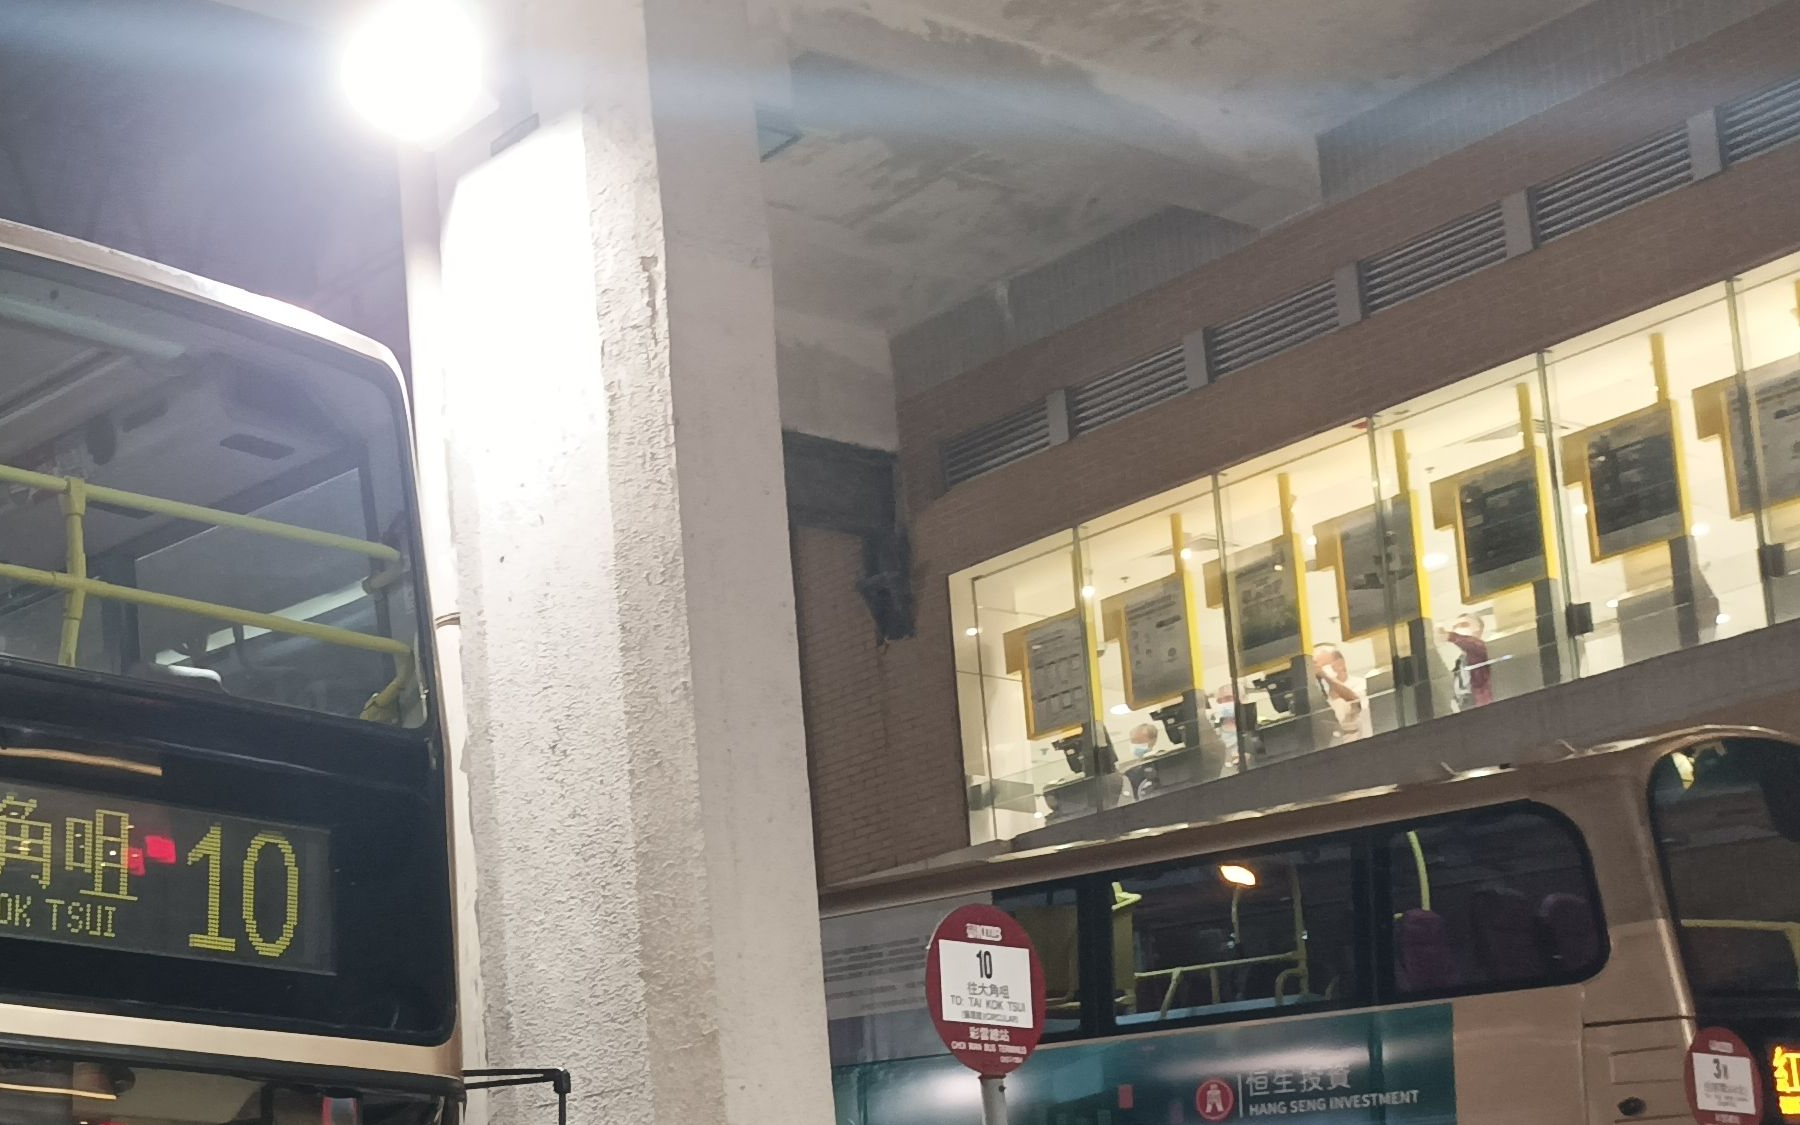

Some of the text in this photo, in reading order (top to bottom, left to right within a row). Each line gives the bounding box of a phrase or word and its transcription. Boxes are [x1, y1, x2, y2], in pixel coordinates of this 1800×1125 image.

[186, 821, 299, 958] 10
[44, 898, 116, 938] TSUI
[975, 950, 993, 979] 10
[967, 981, 1010, 999] 往大角咀
[969, 997, 982, 1007] TAI
[985, 999, 1004, 1011] KOK
[1008, 1001, 1026, 1013] TSUI
[1249, 1089, 1419, 1116] HANG SENG INVESTMENT
